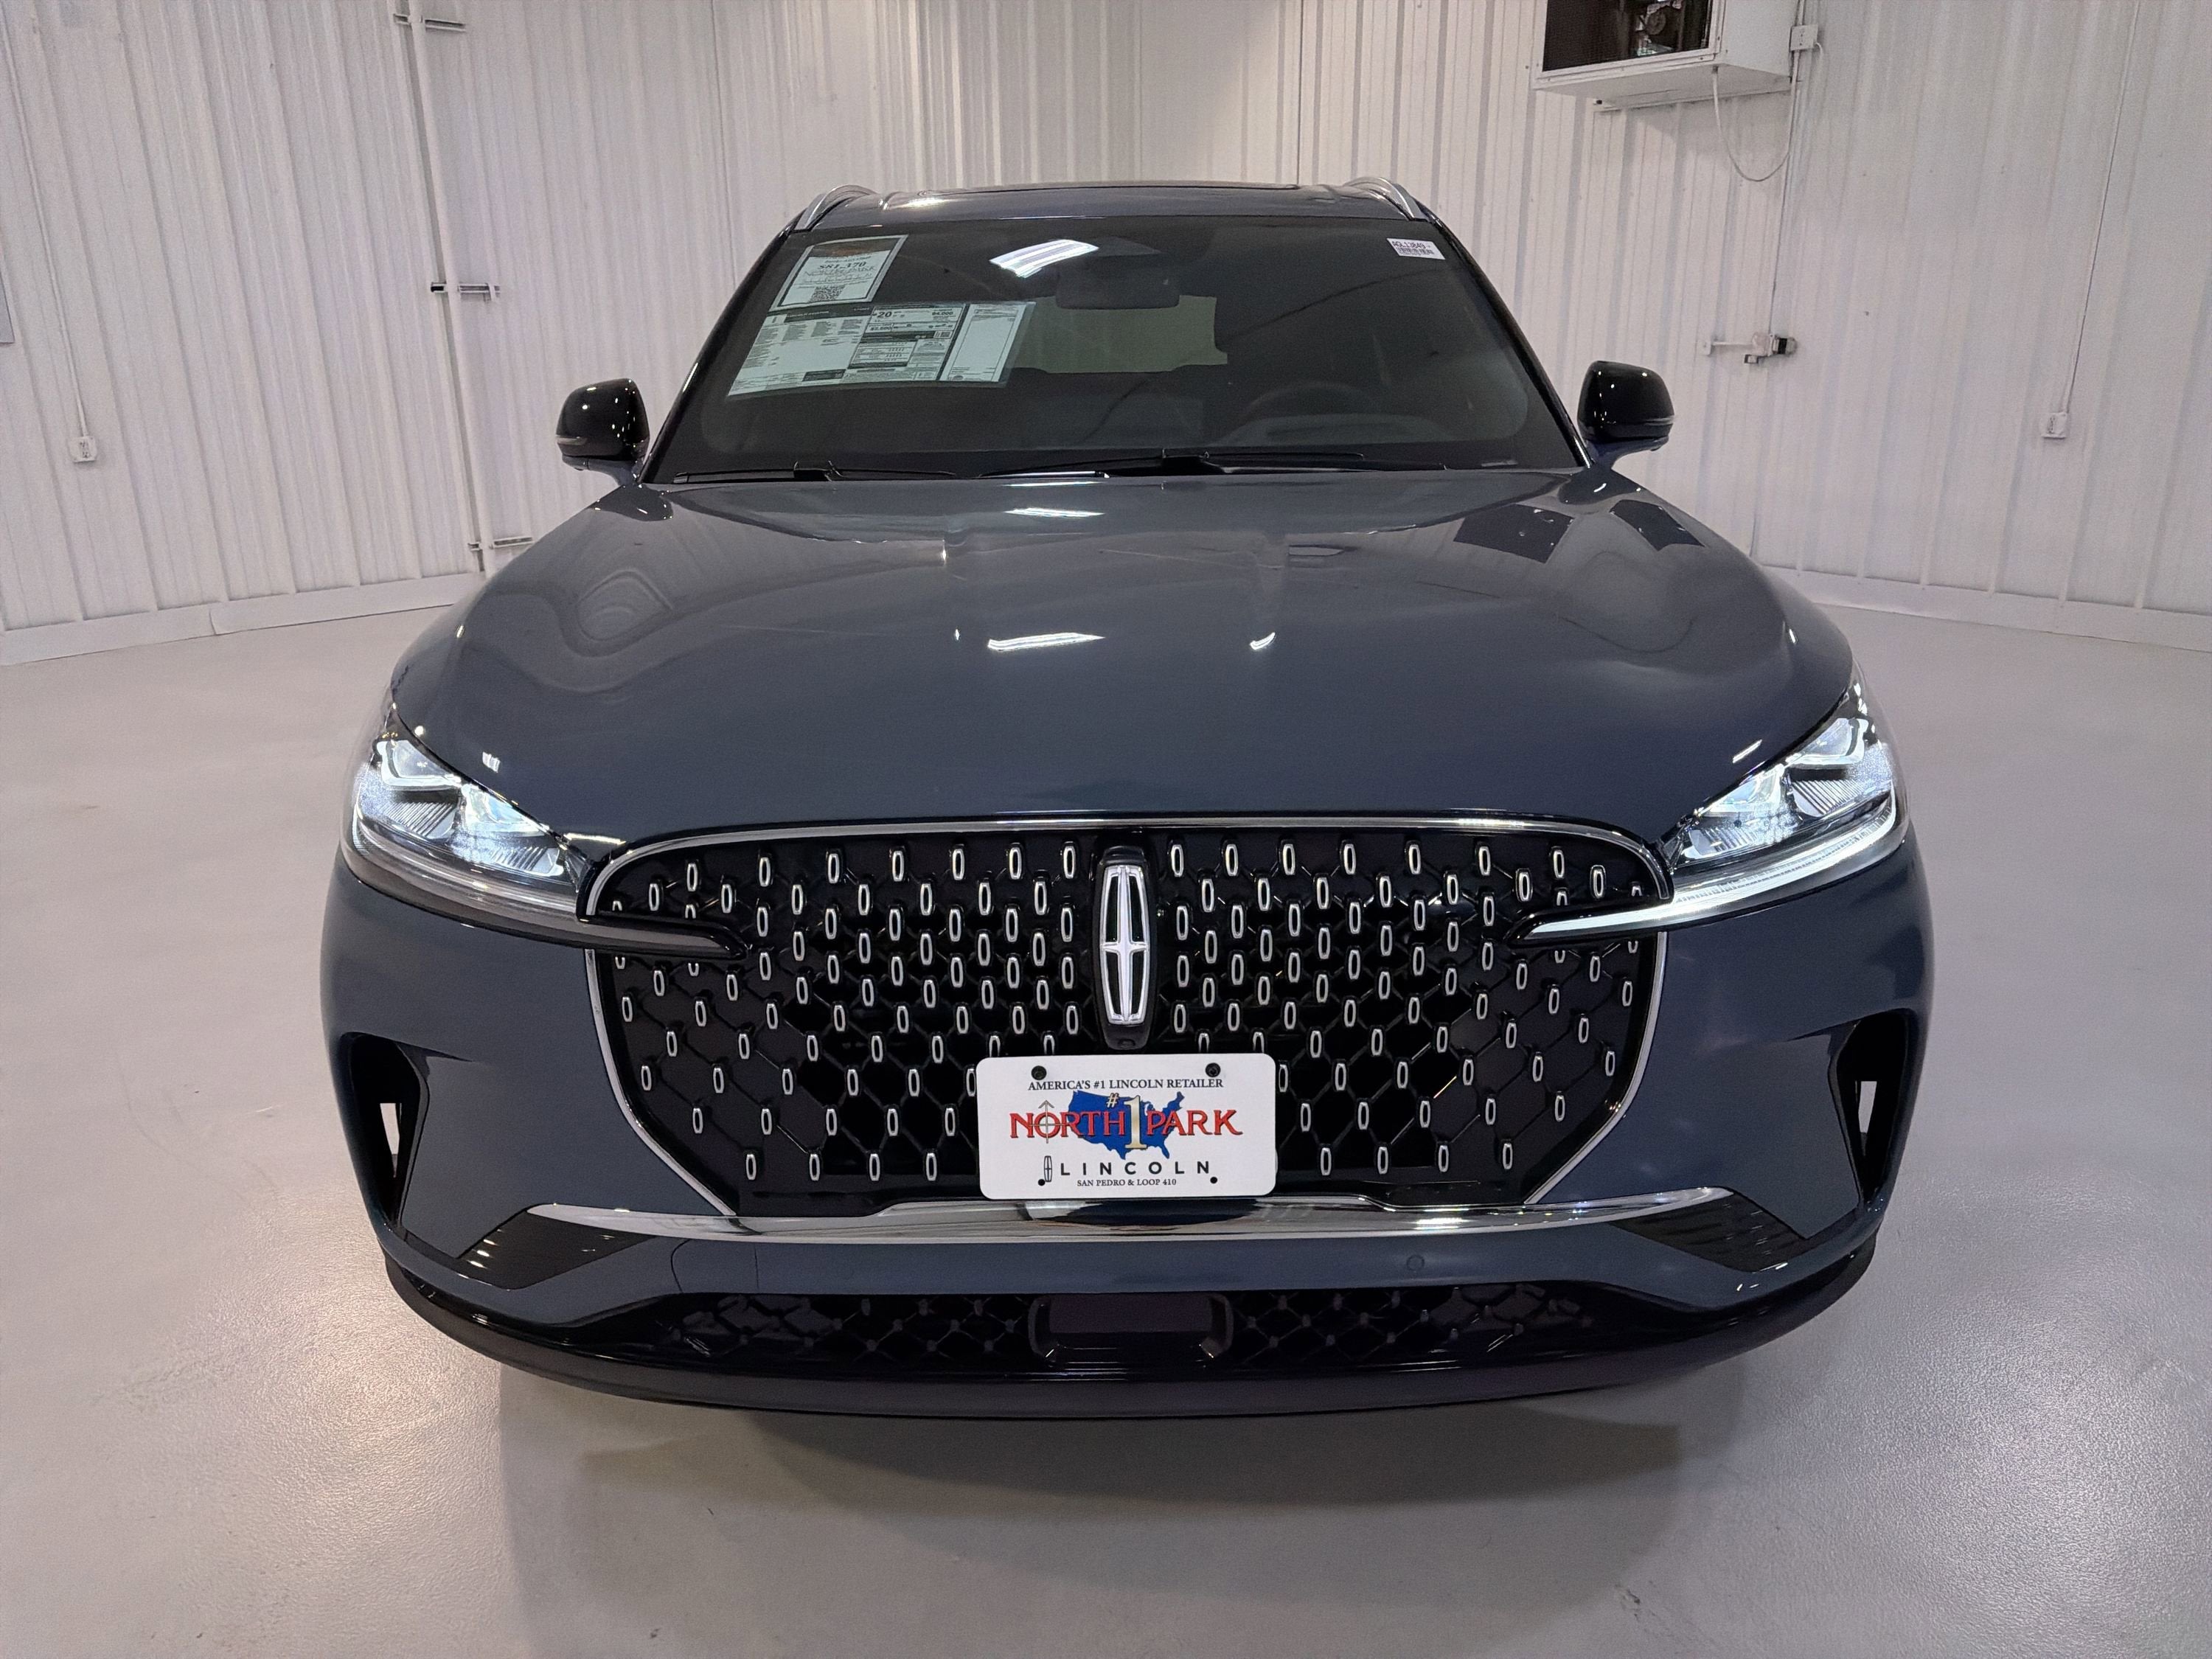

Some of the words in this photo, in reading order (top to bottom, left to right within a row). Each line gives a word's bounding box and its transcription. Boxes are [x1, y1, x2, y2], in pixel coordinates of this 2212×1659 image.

[1027, 1080, 1091, 1091] AMERICA'S
[1093, 1080, 1106, 1089] #1
[1109, 1079, 1164, 1089] LINCOLN
[1166, 1078, 1224, 1088] RETAILER
[1010, 1109, 1126, 1139] NORTH
[1146, 1109, 1243, 1136] PARK
[1060, 1161, 1209, 1176] LINCOLN
